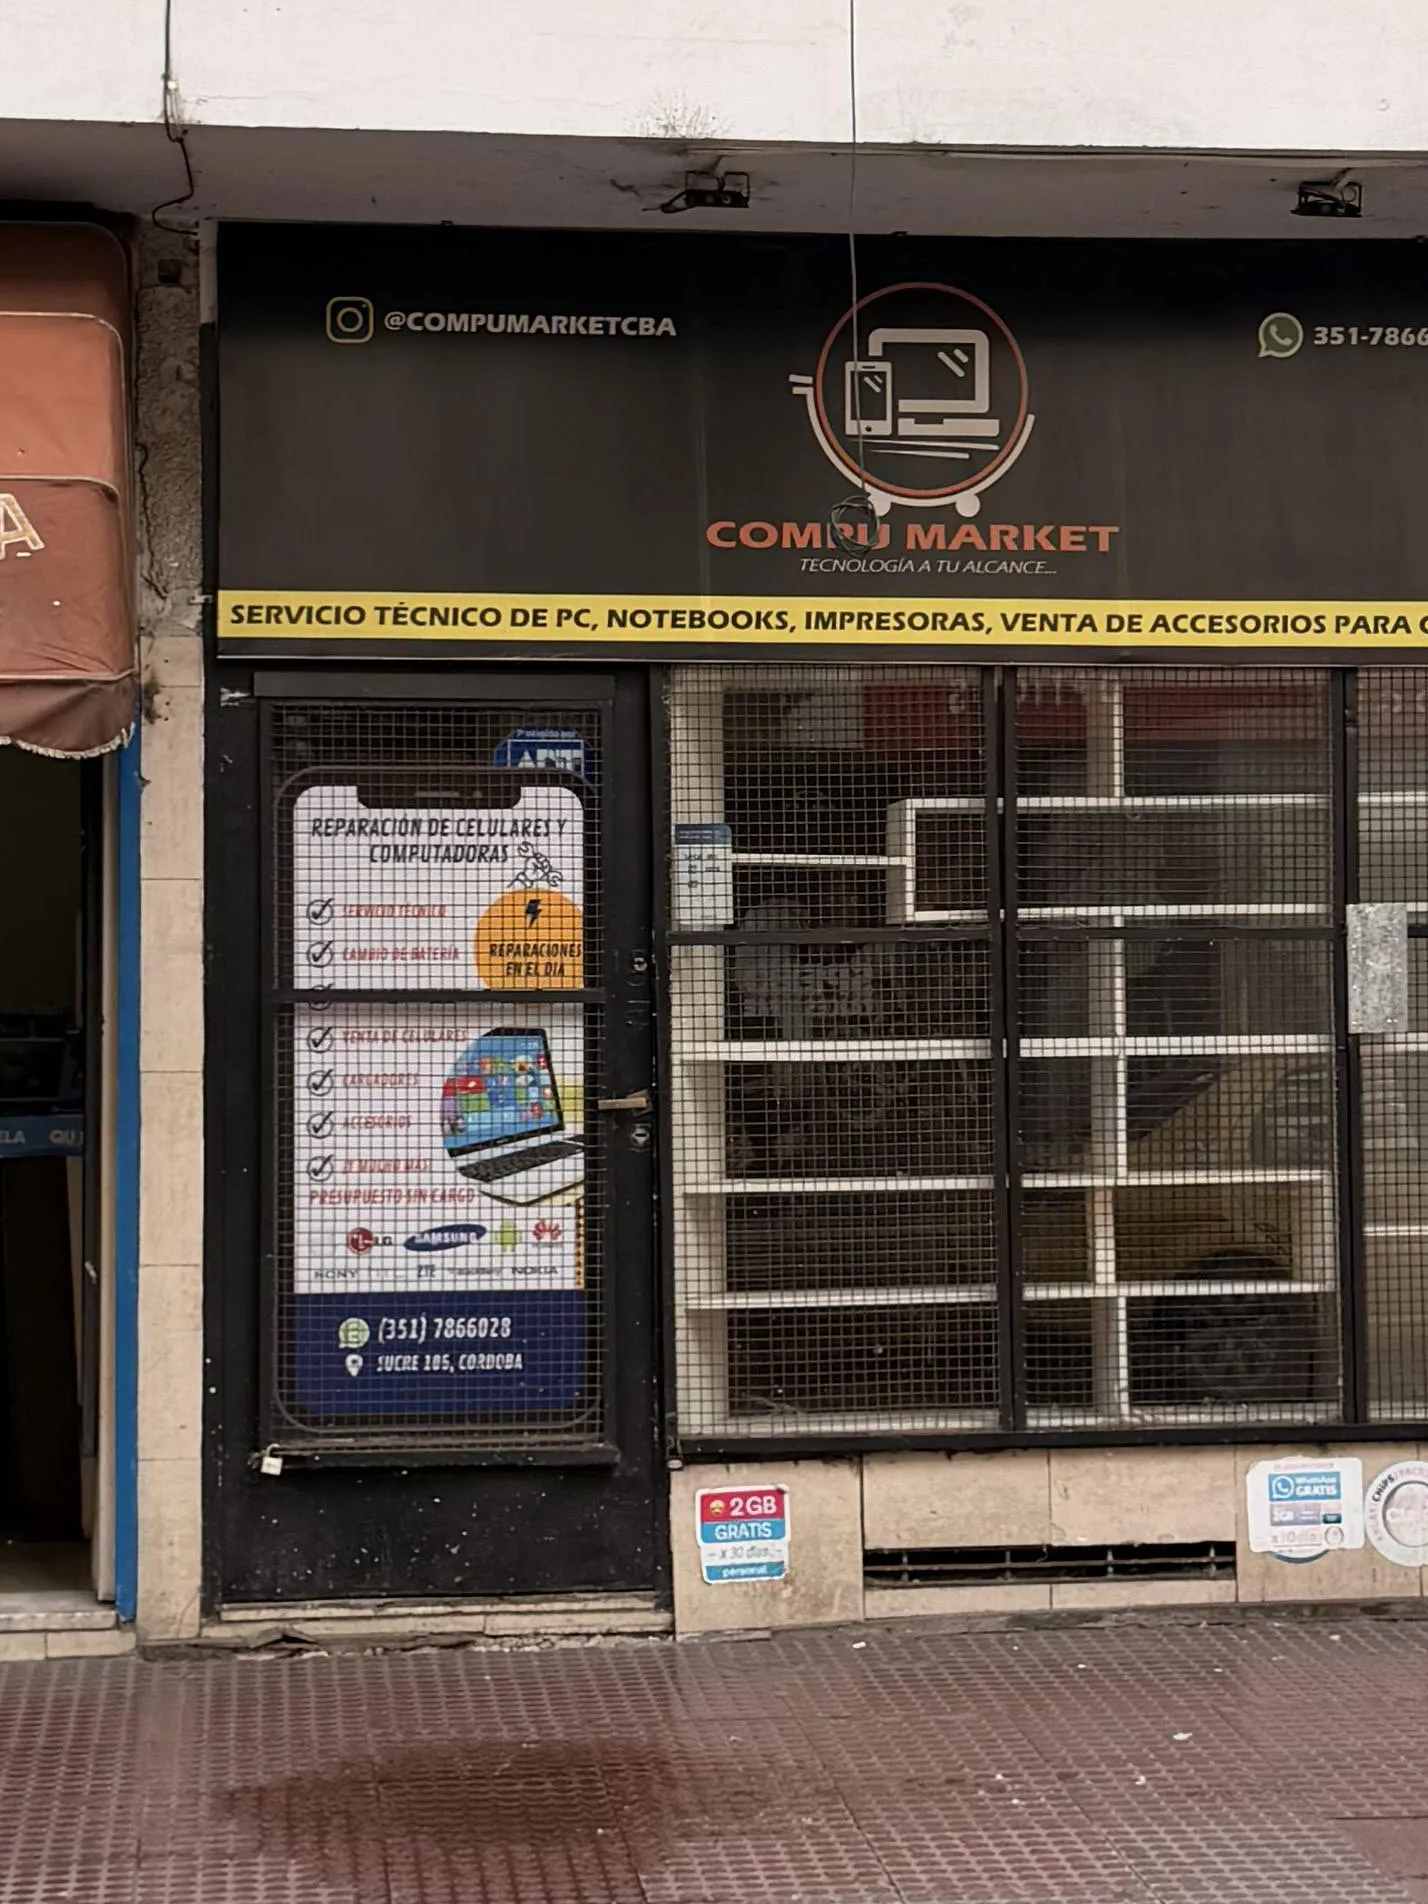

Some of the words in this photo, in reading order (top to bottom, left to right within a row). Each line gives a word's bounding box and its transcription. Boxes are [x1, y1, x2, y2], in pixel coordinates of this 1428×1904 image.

[384, 311, 677, 336] @COMPUMARKETCBA
[705, 520, 891, 552] COMPU
[906, 523, 1120, 553] MARKET
[799, 556, 916, 573] TECNOLOGÍA
[917, 560, 932, 572] A
[938, 561, 961, 573] TU
[230, 604, 367, 626] SERVICIO
[374, 602, 502, 627] TÉCNICO
[509, 608, 548, 627] DE
[556, 608, 600, 631] PC,
[607, 609, 797, 633] NOTEBOOKS,
[804, 610, 994, 635] IMPRESORAS,
[1000, 613, 1098, 632] VENTA
[1106, 614, 1143, 633] DE
[1149, 614, 1327, 634] ACCESORIOS
[1335, 615, 1413, 634] PARA
[428, 819, 450, 837] DE
[456, 818, 551, 837] CELULARES
[557, 818, 567, 836] Y
[370, 844, 509, 864] COMPUTADORAS
[489, 942, 582, 959] REPARACIONES
[506, 962, 523, 977] EN
[525, 962, 540, 977] EL
[415, 1231, 477, 1246] SAMSUNG
[378, 1315, 427, 1344] (351)
[433, 1317, 512, 1339] 7866028
[376, 1354, 420, 1372] SUCRE
[1295, 1485, 1337, 1497] GRATIS
[714, 1522, 773, 1540] GRATIS
